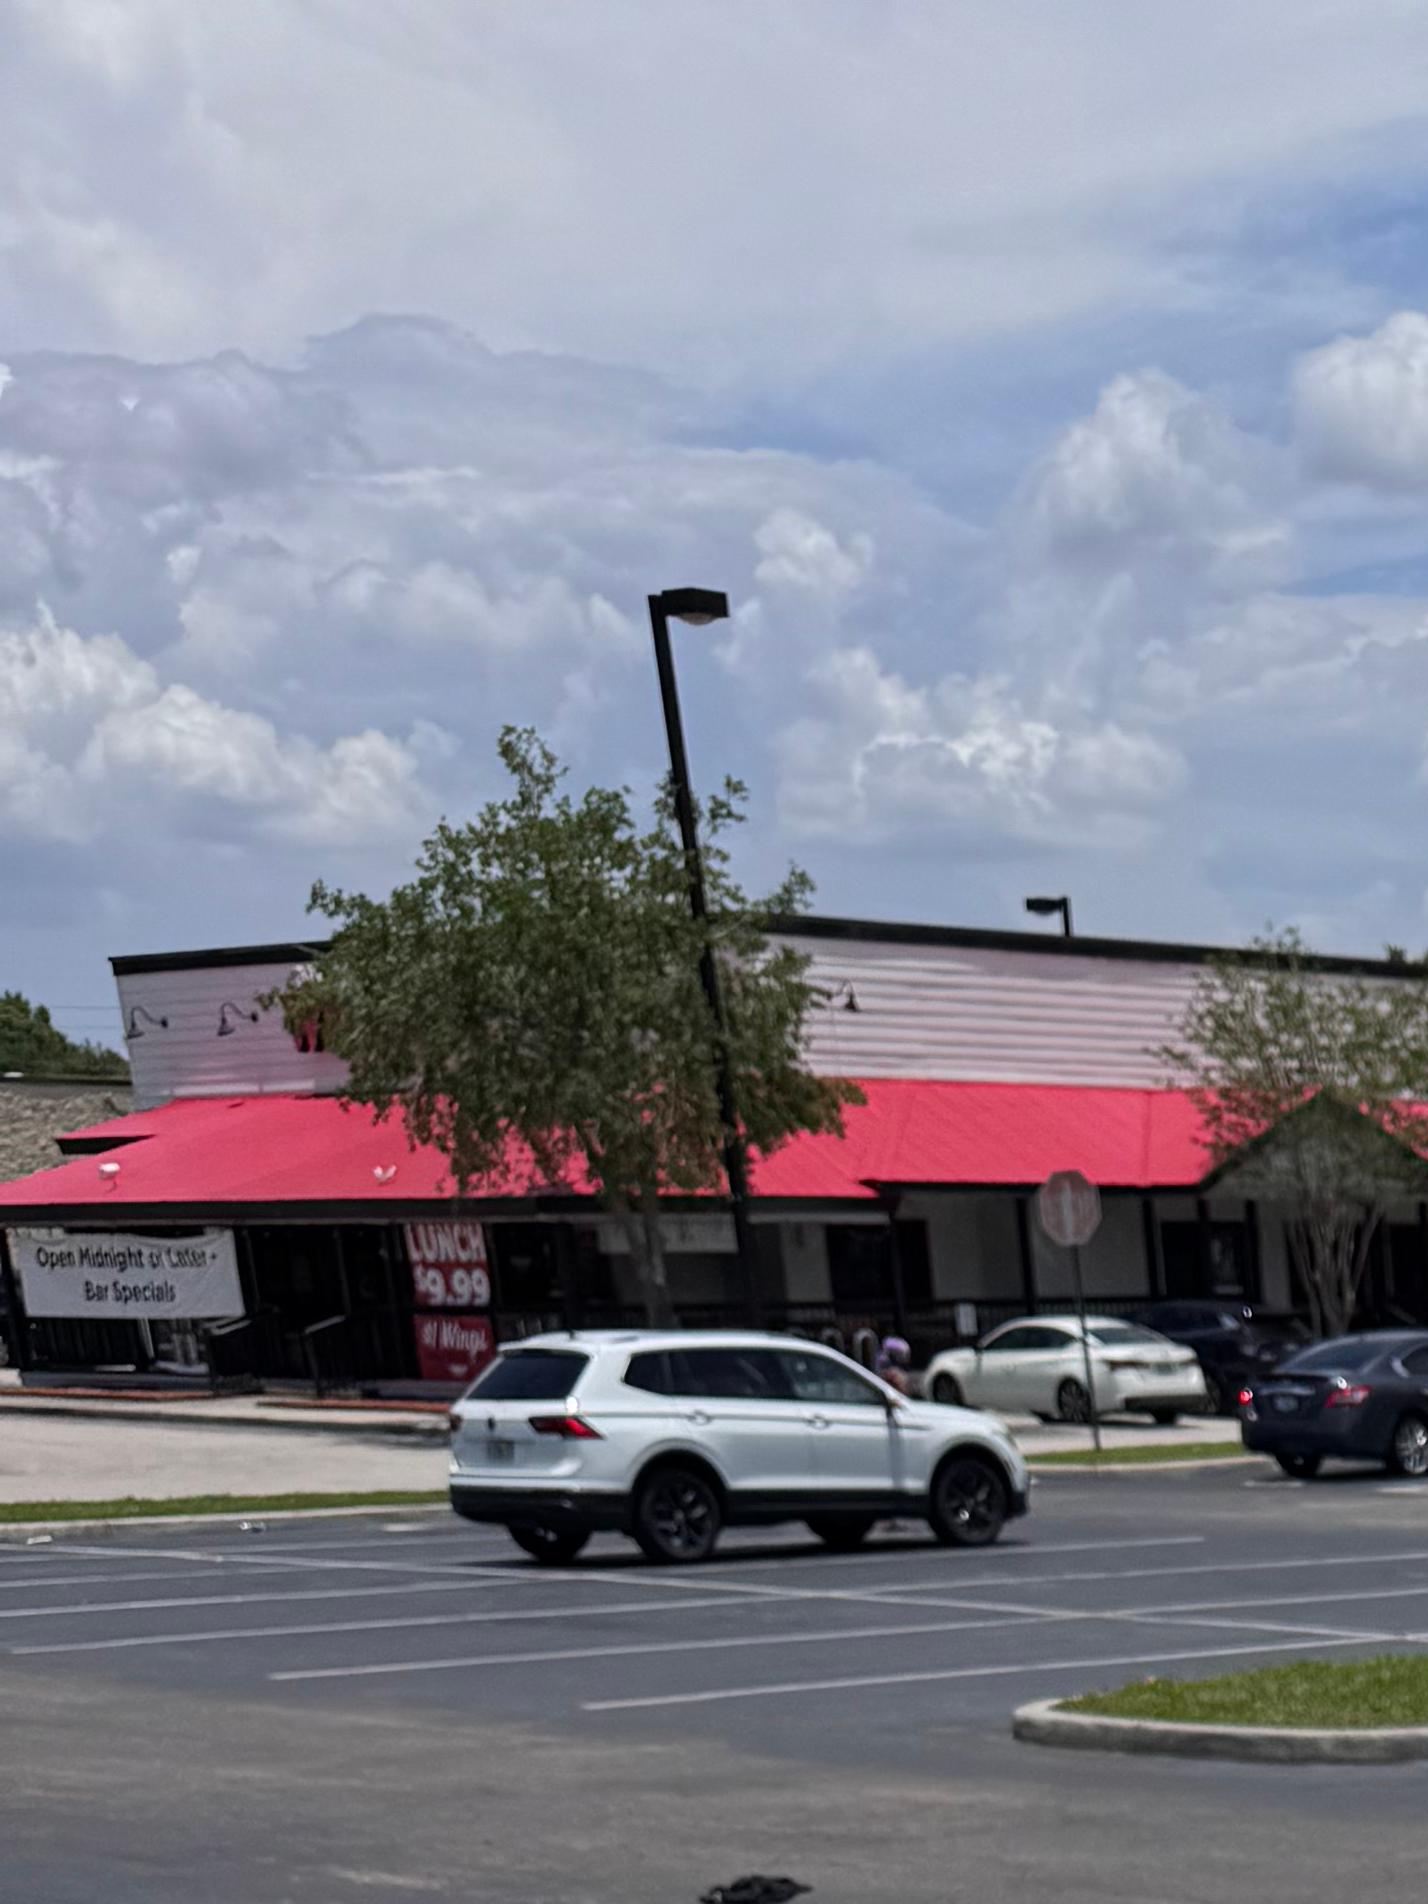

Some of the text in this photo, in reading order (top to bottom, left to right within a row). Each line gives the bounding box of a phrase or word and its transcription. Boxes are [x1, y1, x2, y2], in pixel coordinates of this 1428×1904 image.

[36, 1247, 76, 1270] Open
[79, 1247, 145, 1273] Midnight
[403, 1223, 487, 1262] LUNCH
[84, 1280, 177, 1304] Bar Specials
[413, 1264, 491, 1306] $9.99
[442, 1320, 489, 1362] Wings
